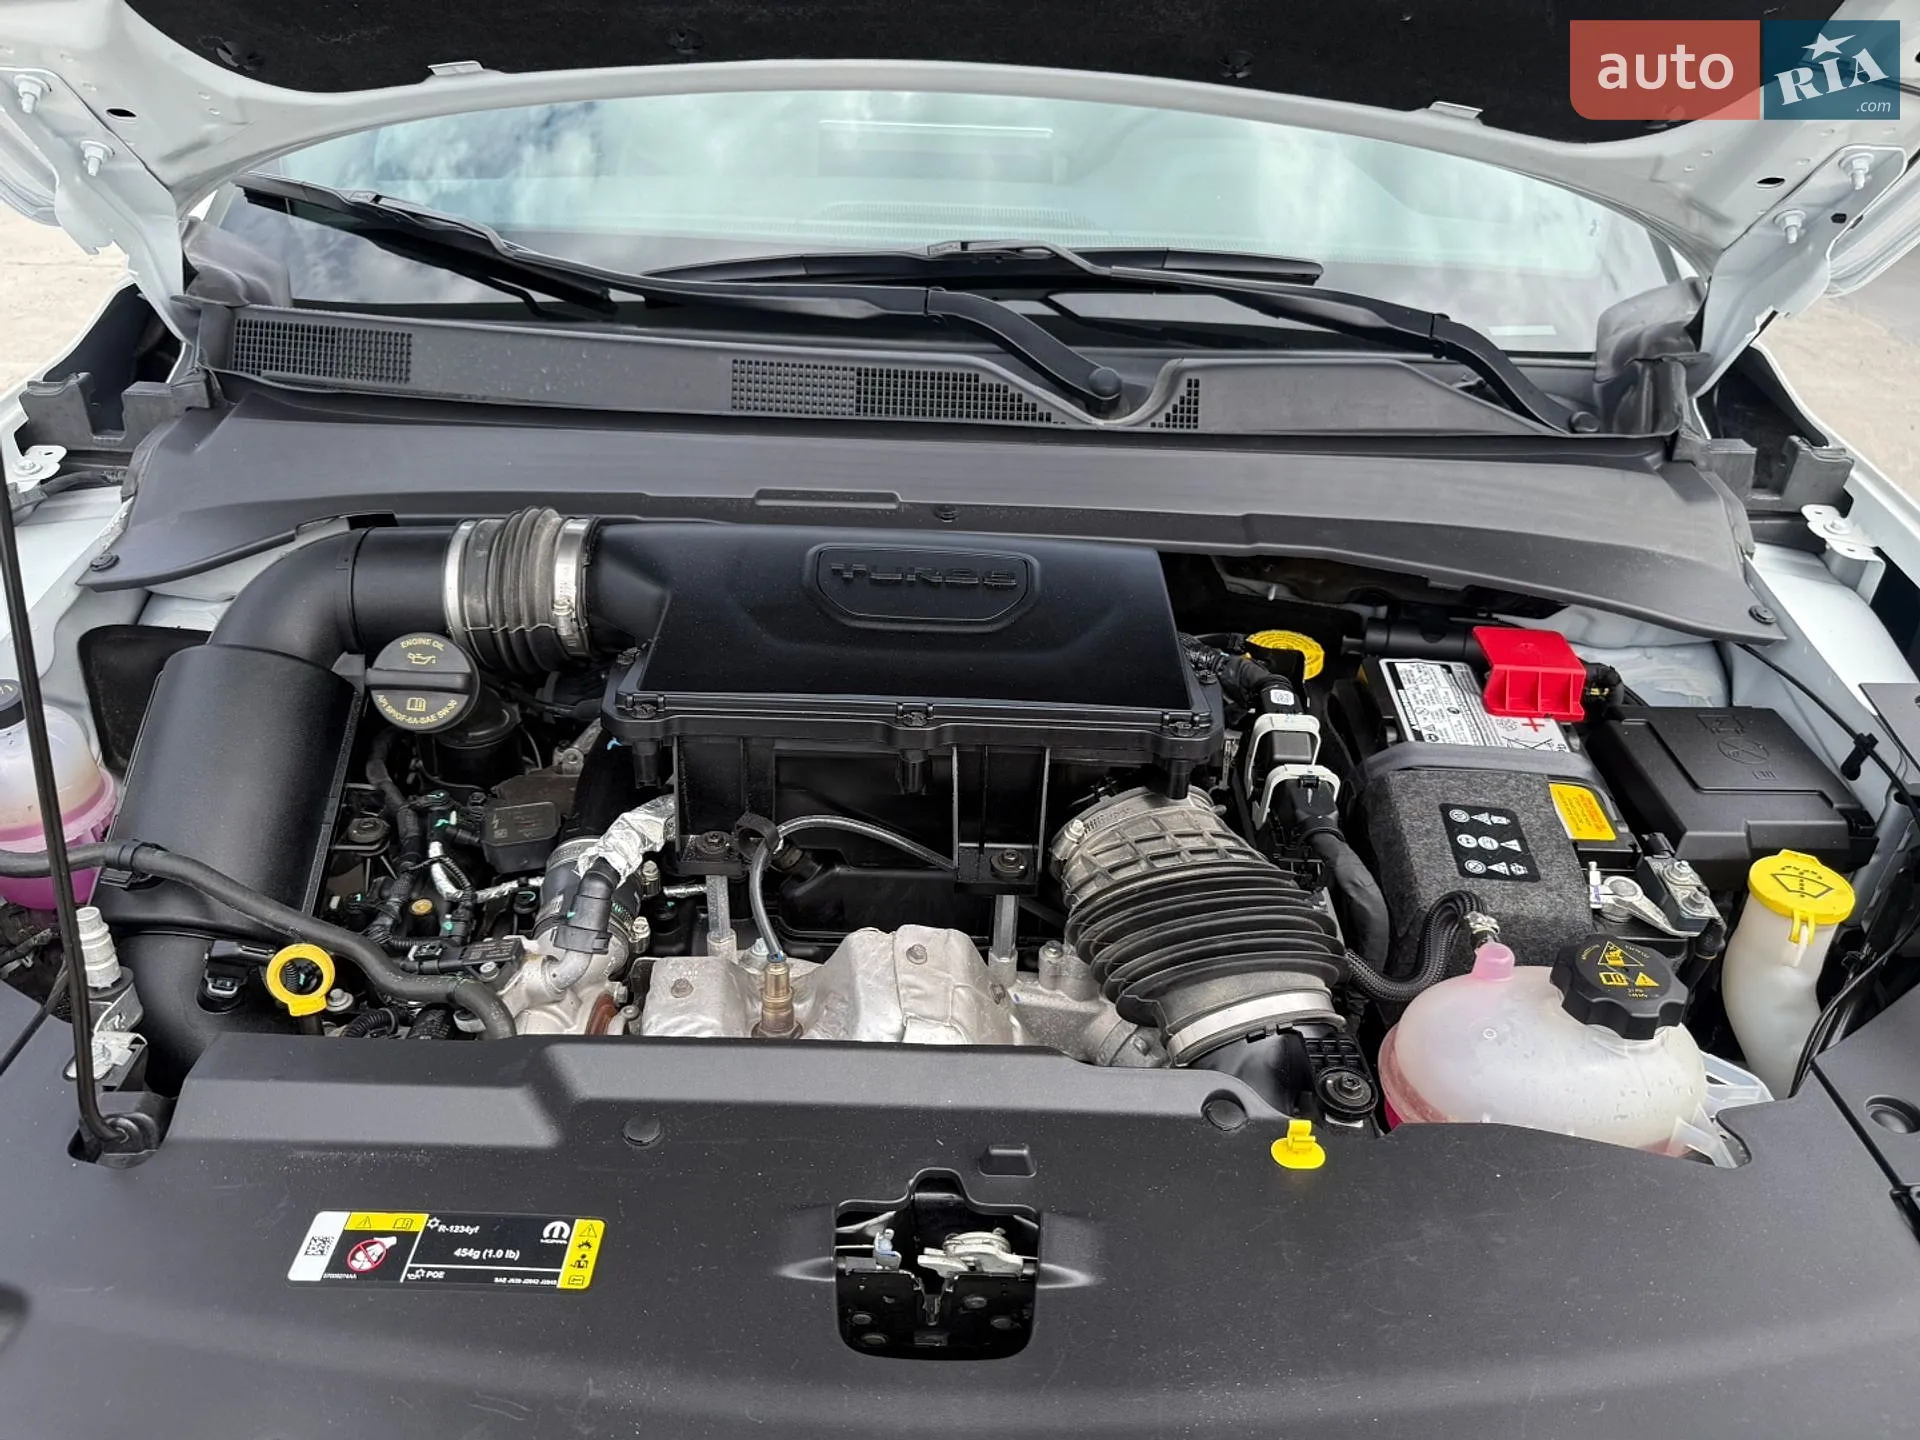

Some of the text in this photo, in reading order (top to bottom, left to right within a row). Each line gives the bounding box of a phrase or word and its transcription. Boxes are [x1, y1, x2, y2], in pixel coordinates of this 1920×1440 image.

[400, 637, 444, 651] ENGINE OIL
[438, 1225, 480, 1235] R-1234yf
[454, 1248, 520, 1261] 454g (1.0 lb)
[426, 1270, 446, 1279] POE
